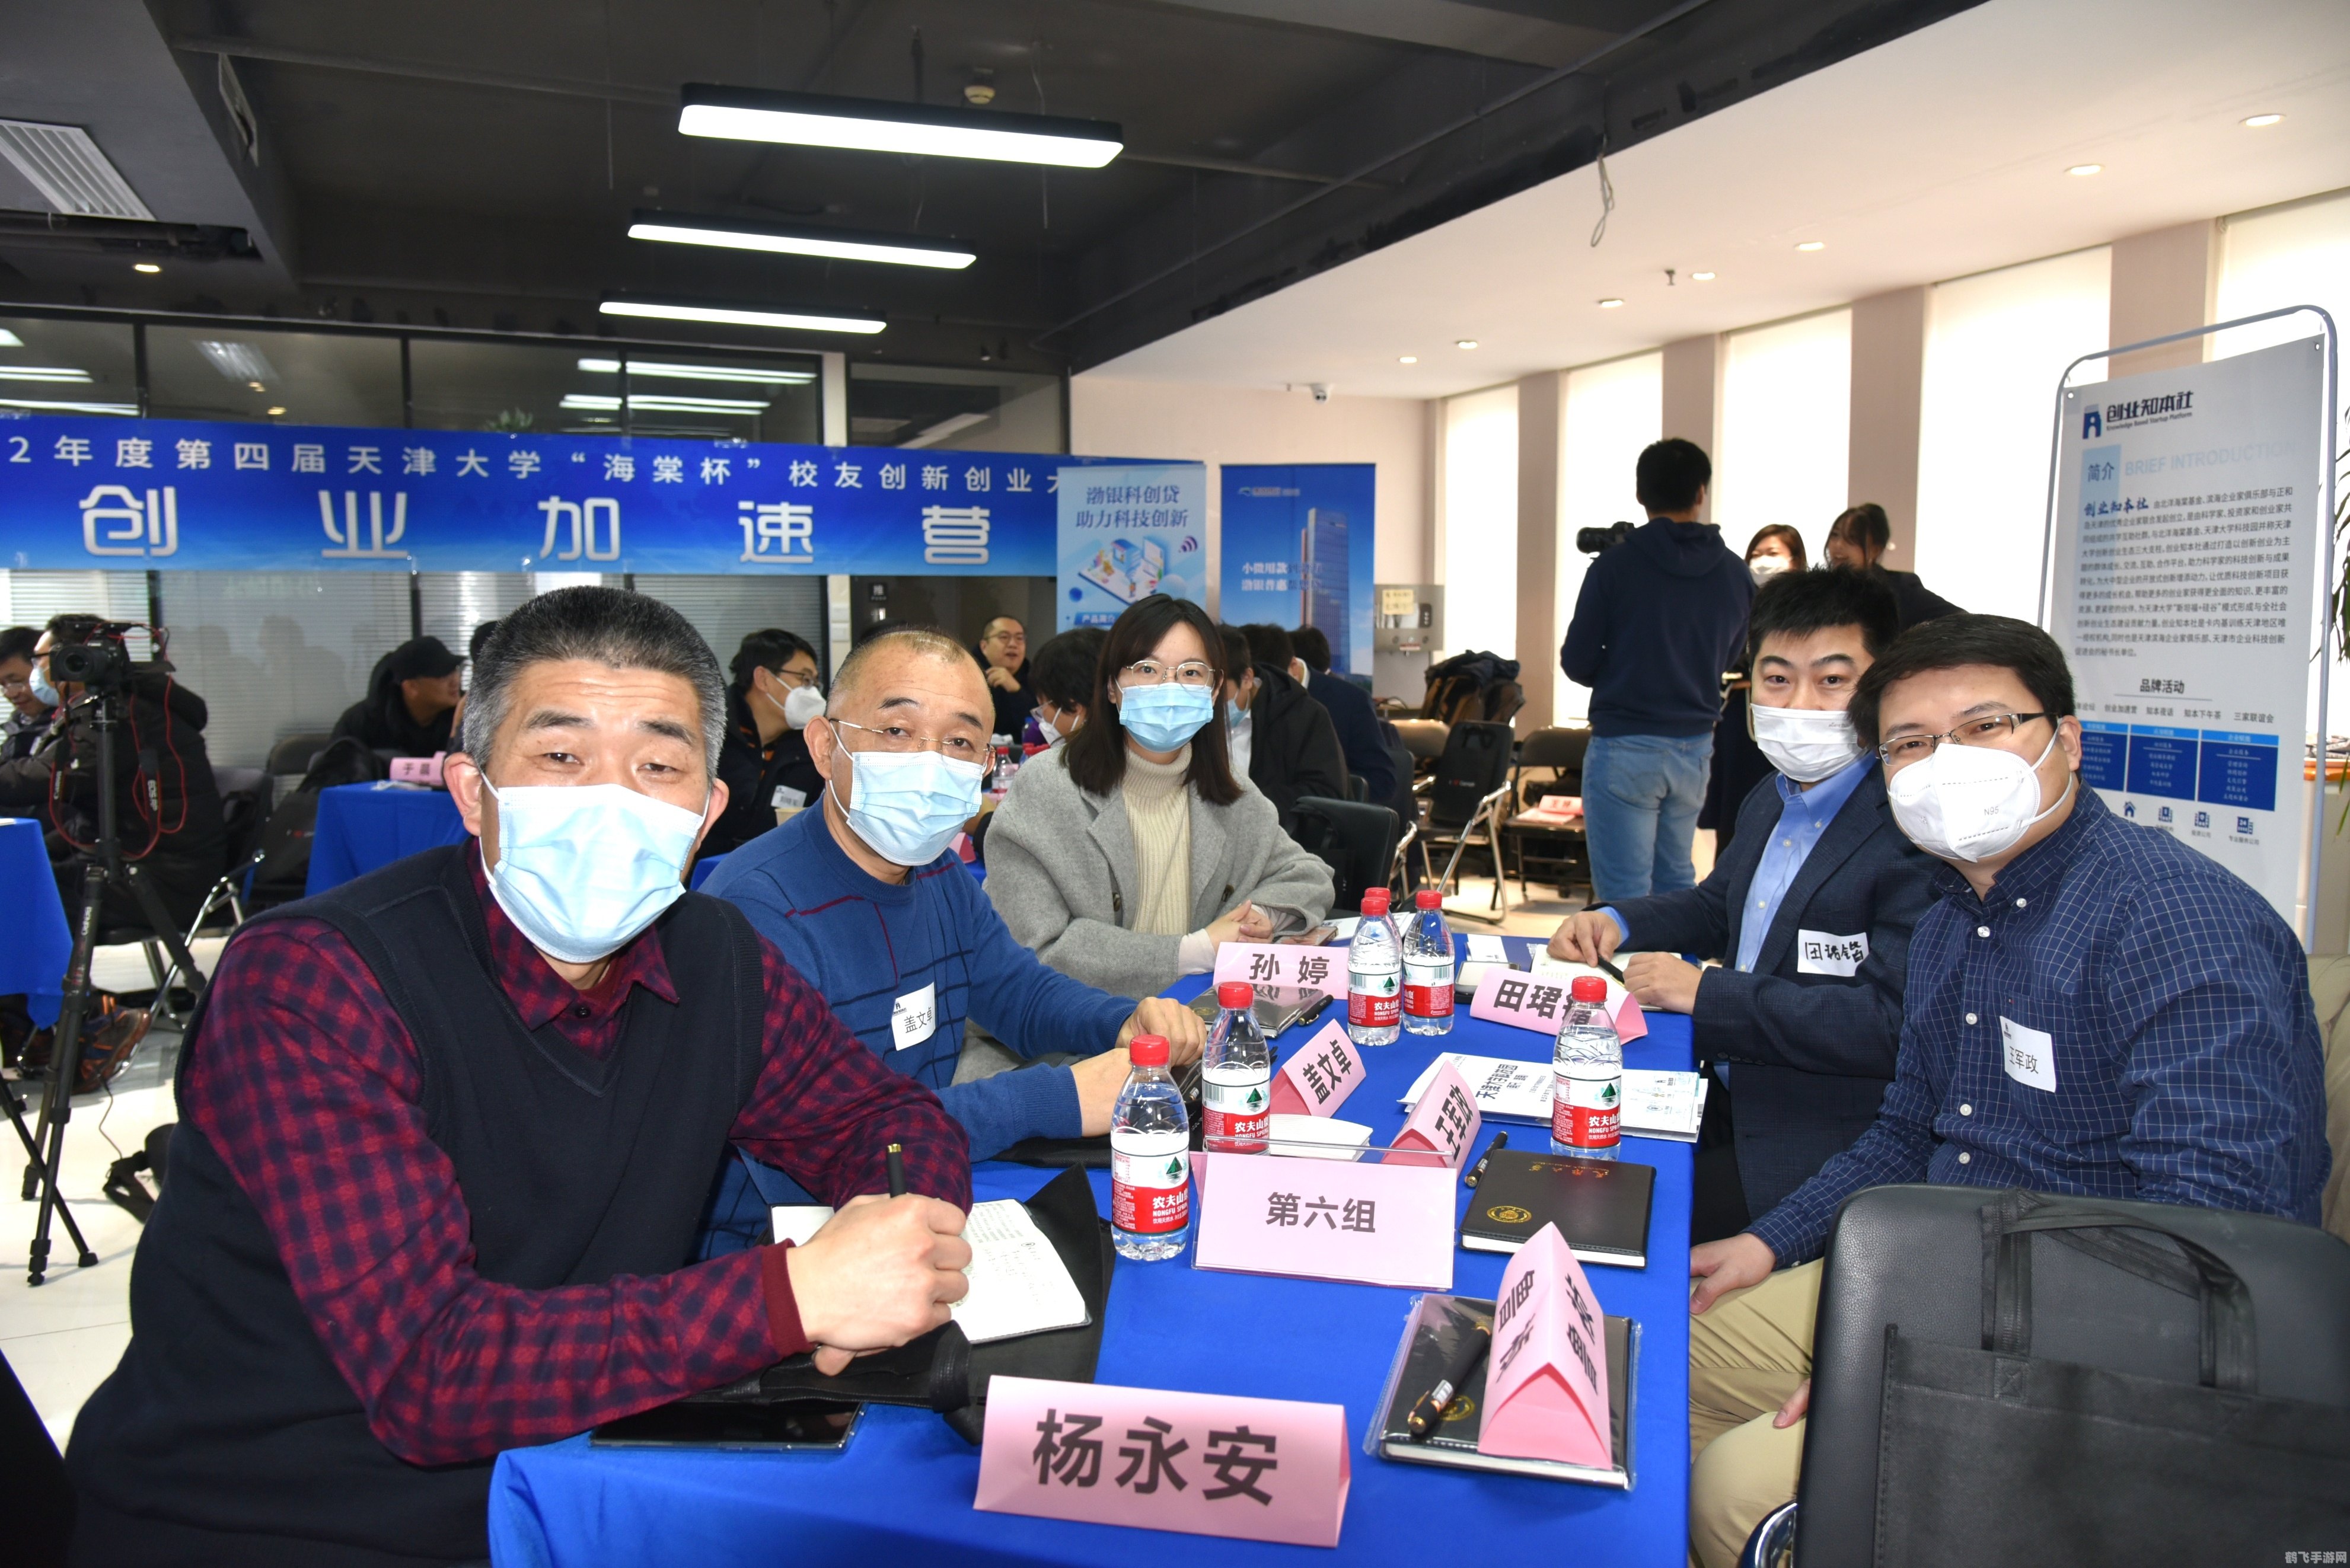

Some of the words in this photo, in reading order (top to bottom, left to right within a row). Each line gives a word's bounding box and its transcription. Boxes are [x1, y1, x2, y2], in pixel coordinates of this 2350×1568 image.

[2088, 462, 2115, 482] 简介
[2125, 456, 2167, 475] BRIEF
[1086, 485, 1179, 504] 渤银科创贷
[1076, 509, 1188, 528] 助力科技创新
[2140, 678, 2185, 694] 品牌活动
[2234, 712, 2275, 724] 三家联谊会
[1249, 953, 1329, 985] 孙婷
[904, 1007, 933, 1033] 盖文卓
[2009, 1046, 2039, 1074] 王军政
[1302, 1039, 1353, 1105] 盖文卓
[1435, 1084, 1473, 1162] 王军政
[1153, 1207, 1176, 1217] NONGFU
[1265, 1192, 1376, 1234] 第六组
[1032, 1408, 1278, 1506] 杨永安
